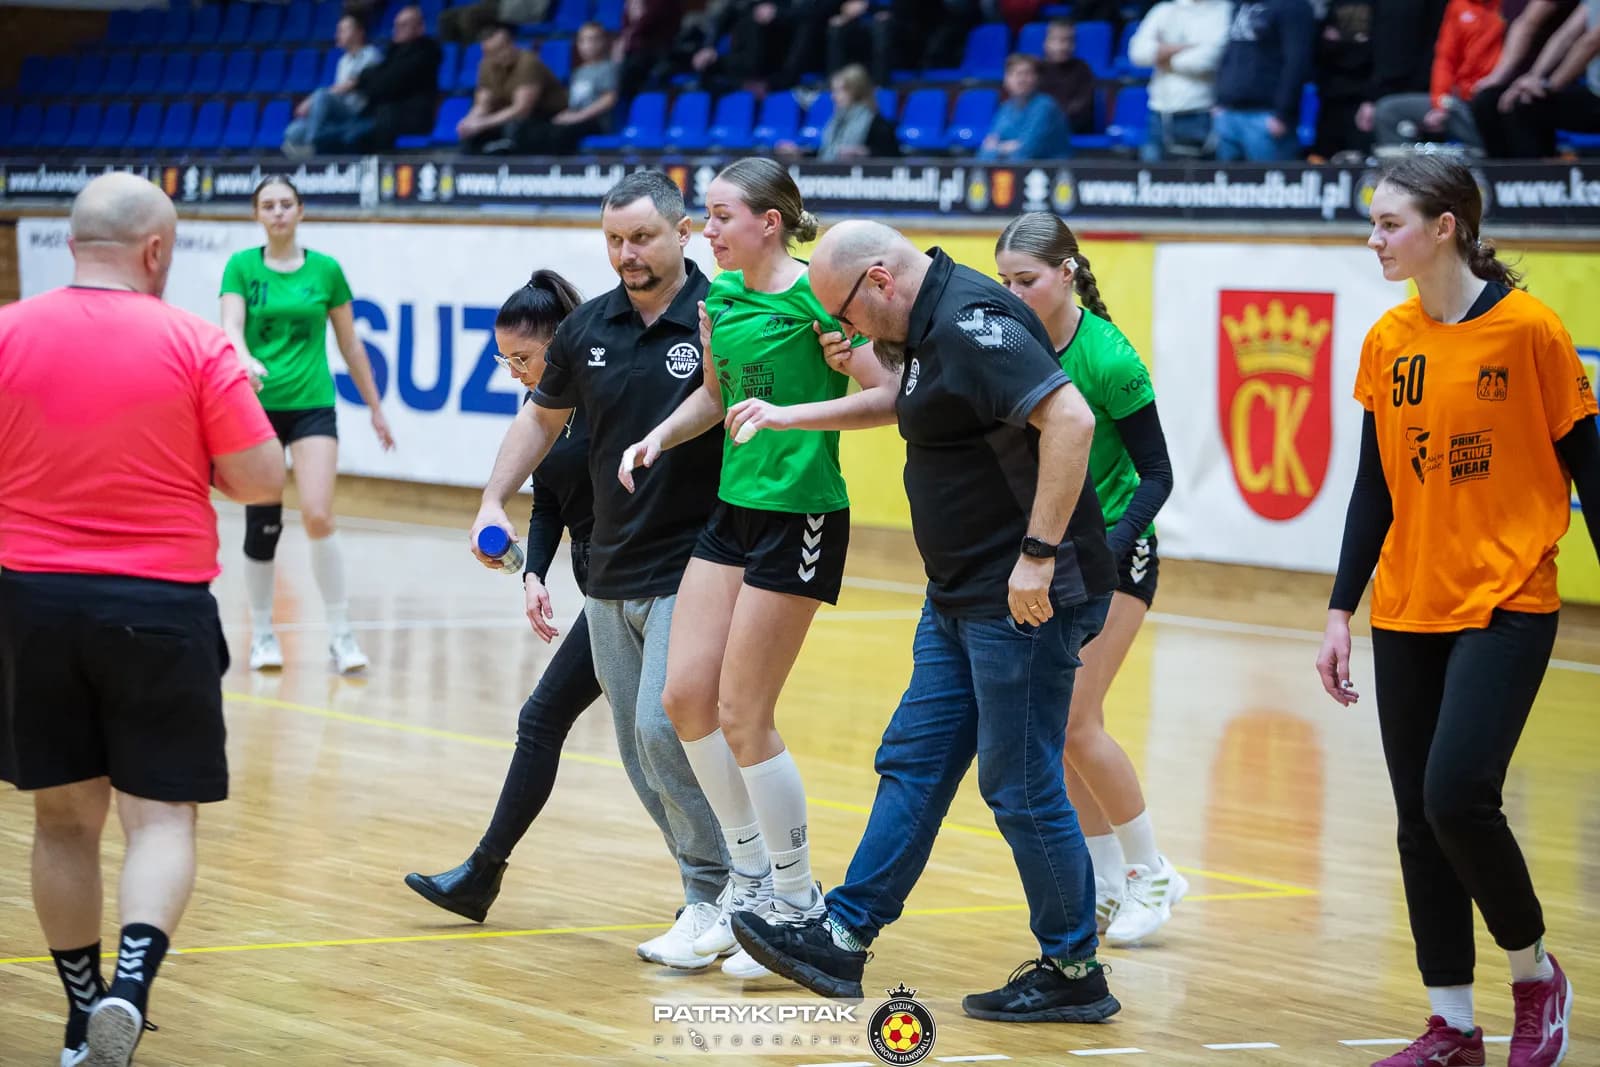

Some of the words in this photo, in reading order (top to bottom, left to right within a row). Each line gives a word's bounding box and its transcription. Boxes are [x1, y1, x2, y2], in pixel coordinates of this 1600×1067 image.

[1078, 169, 1353, 220] www.koronahandball.pl
[334, 298, 518, 415] SUZ
[671, 360, 694, 372] AWF
[1392, 354, 1426, 408] 50
[1231, 379, 1313, 497] CK
[1449, 445, 1492, 464] ACTIVE
[1450, 434, 1481, 449] PRINT
[1450, 459, 1490, 478] WEAR
